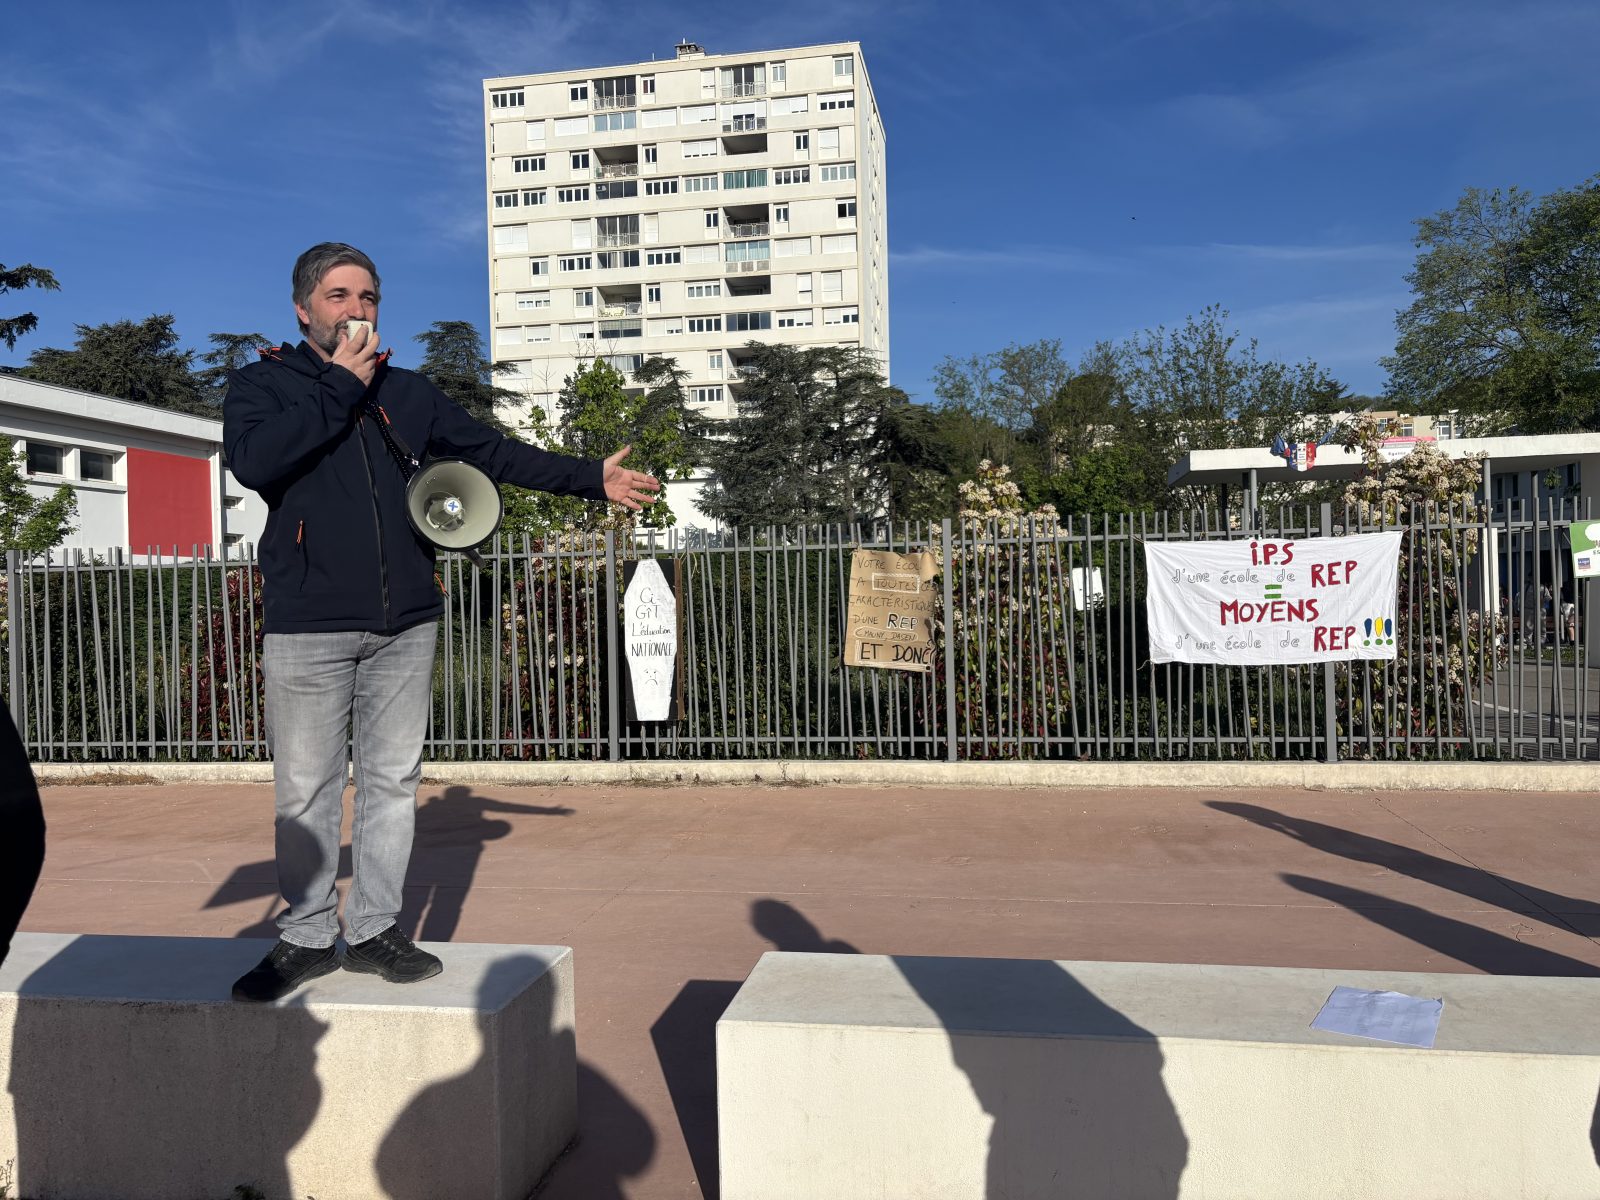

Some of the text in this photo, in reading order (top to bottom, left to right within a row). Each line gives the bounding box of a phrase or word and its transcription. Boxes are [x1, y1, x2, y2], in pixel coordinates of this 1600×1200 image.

[858, 557, 886, 570] VOTRE
[1172, 560, 1358, 588] d'une école de REP
[876, 578, 917, 590] TOUTES
[853, 612, 919, 630] D'UNE REP
[1220, 598, 1319, 626] MOYENS
[1225, 630, 1261, 650] école
[1280, 630, 1300, 648] de
[1314, 626, 1356, 652] REP
[861, 643, 883, 660] ET
